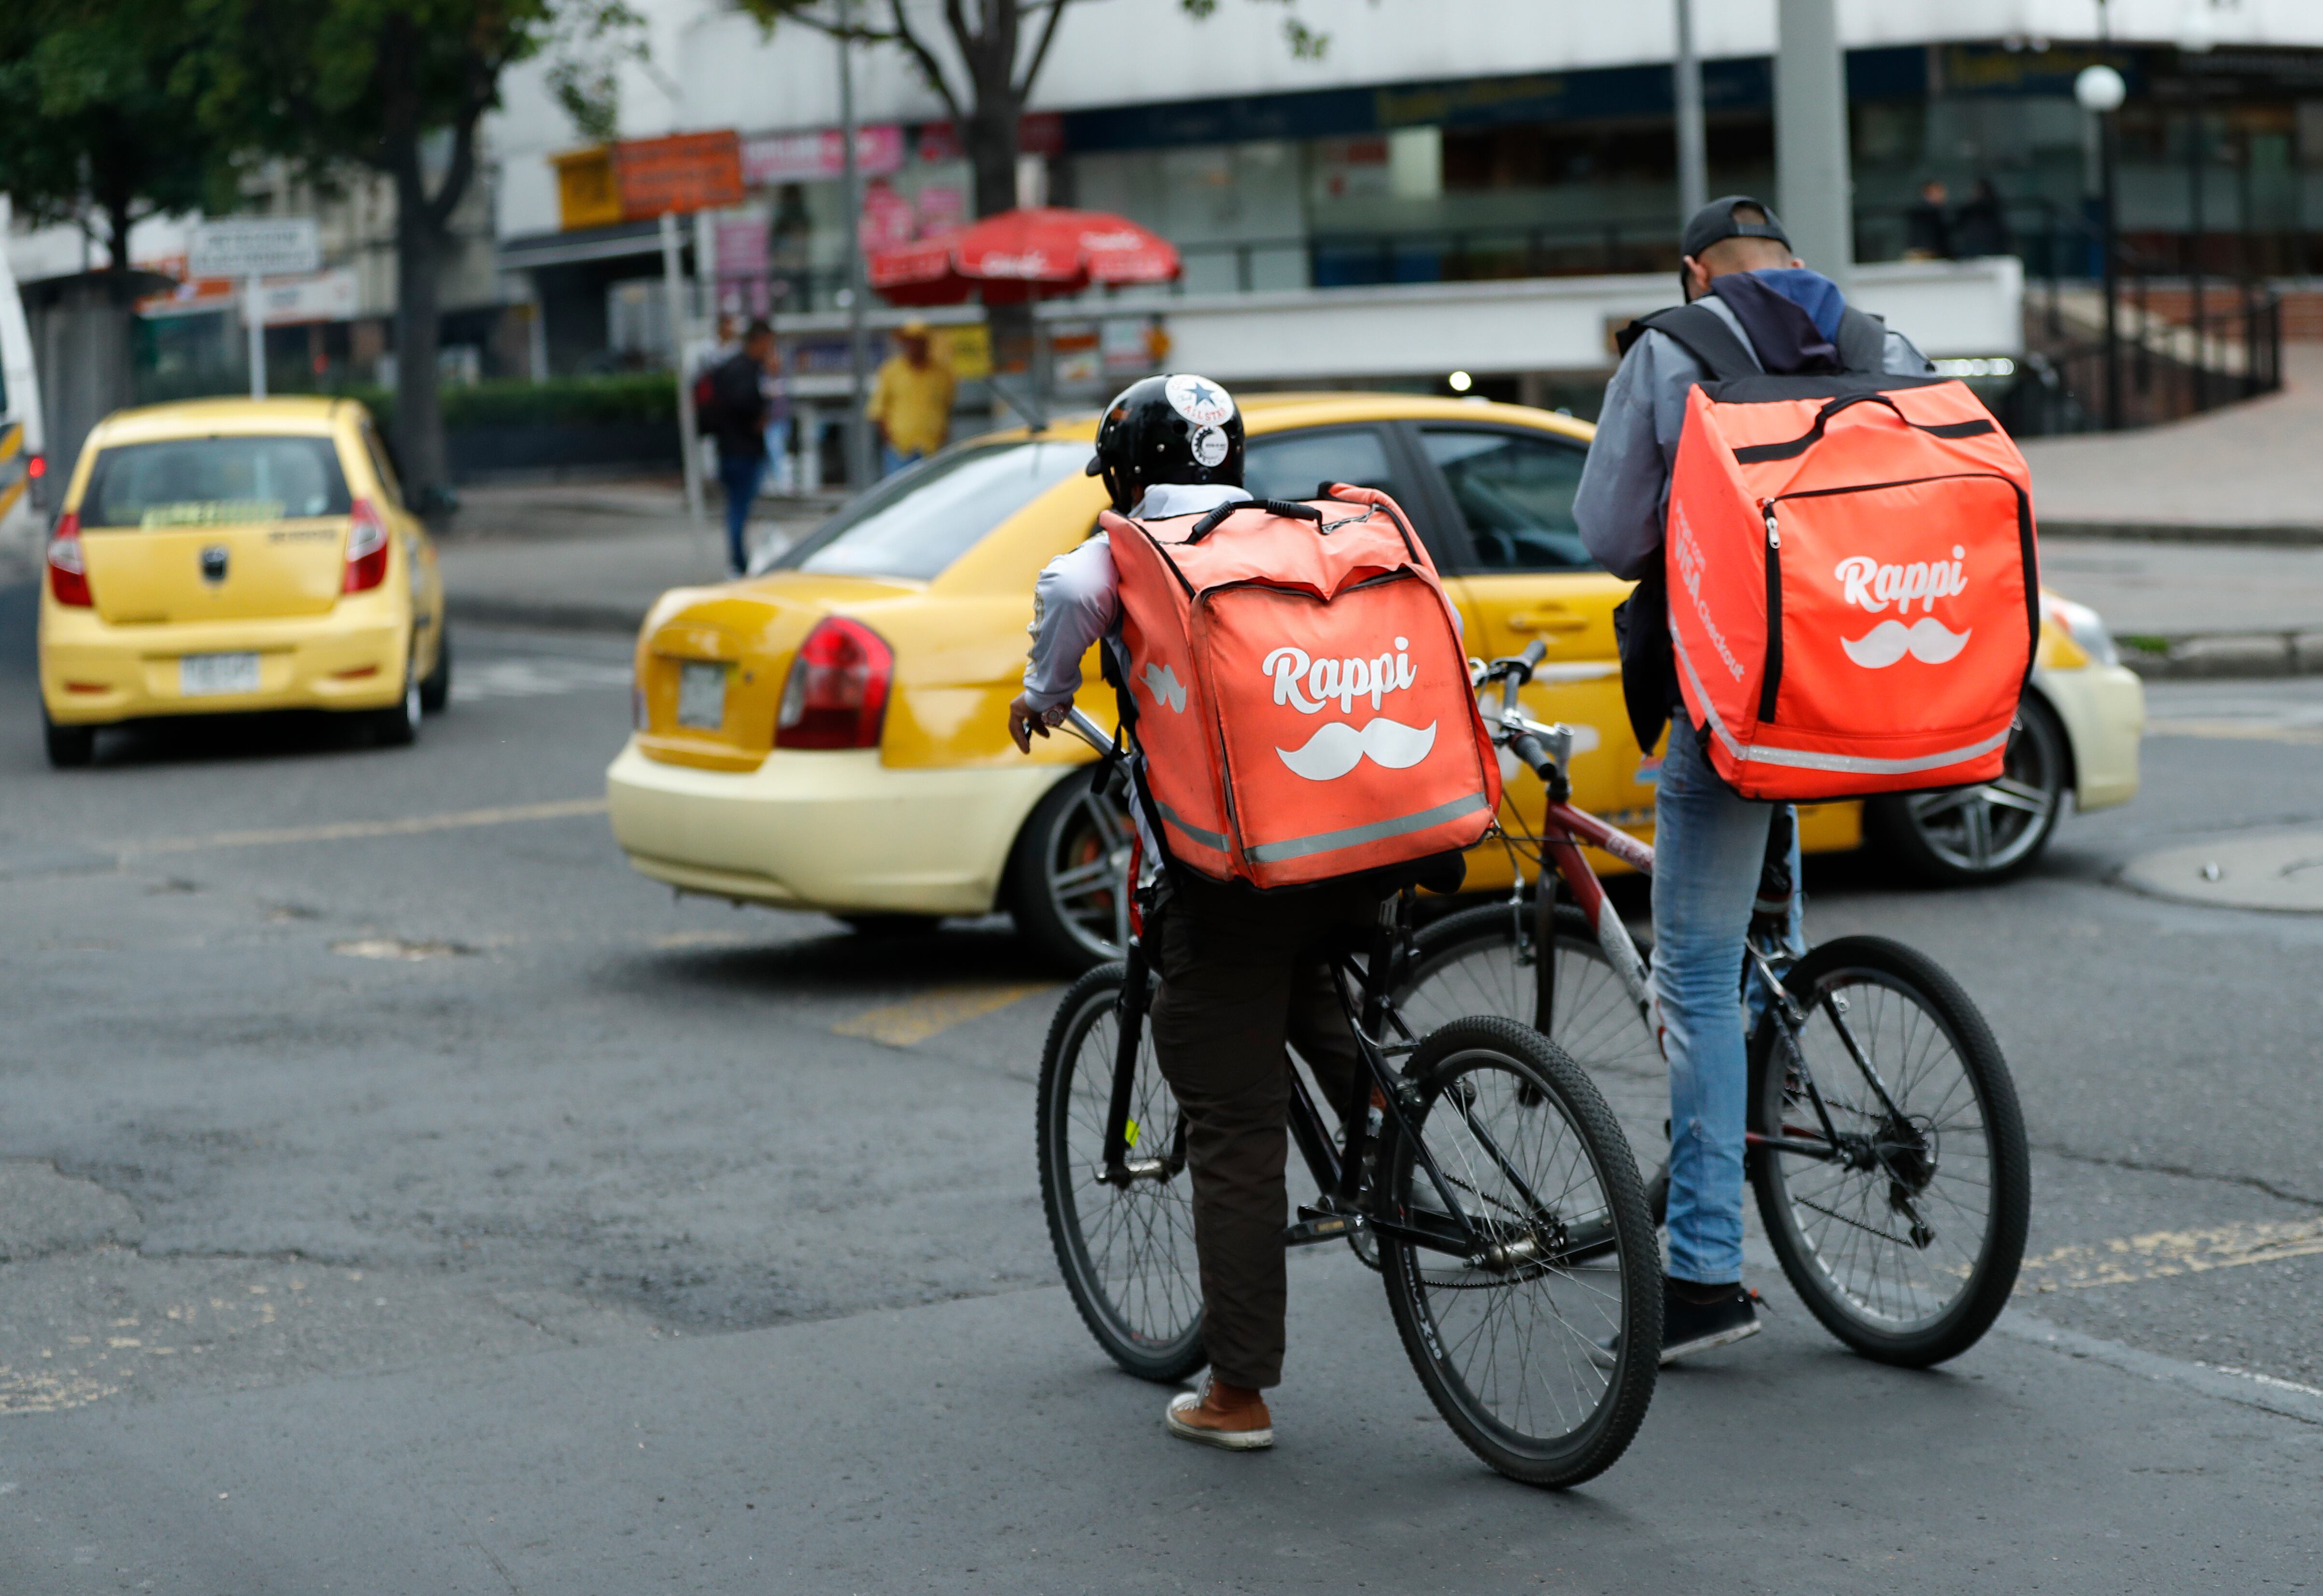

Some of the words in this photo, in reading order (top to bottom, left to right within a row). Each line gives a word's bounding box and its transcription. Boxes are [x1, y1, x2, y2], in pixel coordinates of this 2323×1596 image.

[1675, 520, 1700, 607] VISA
[1834, 545, 1968, 615] Rappi
[1261, 636, 1418, 714] Rappi
